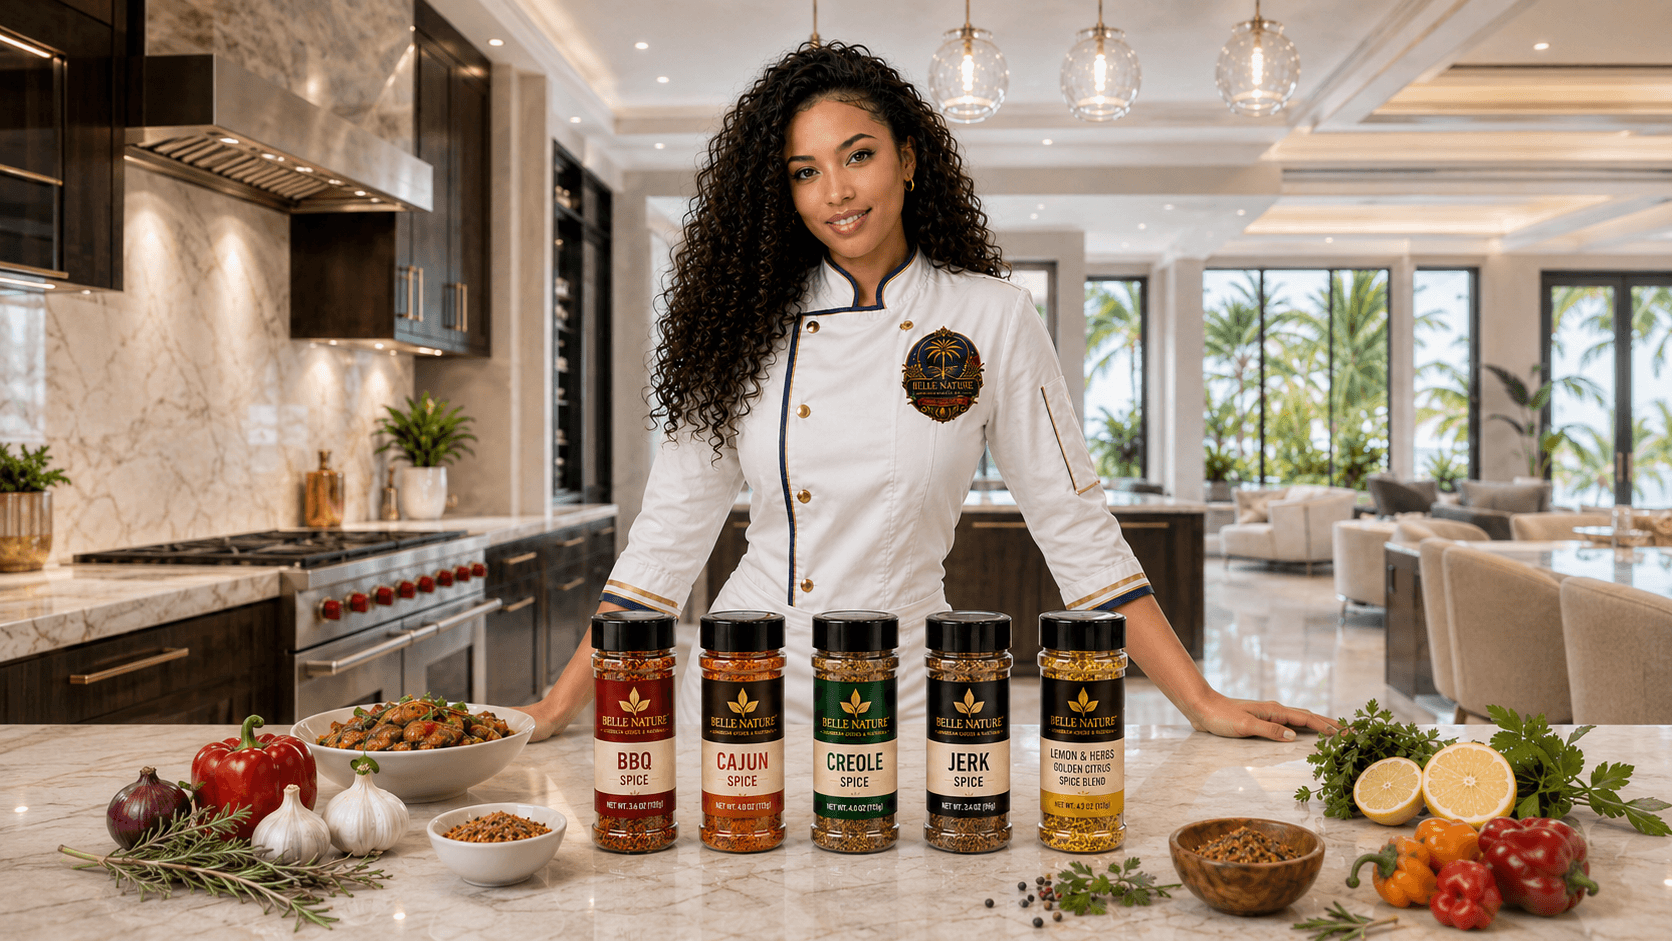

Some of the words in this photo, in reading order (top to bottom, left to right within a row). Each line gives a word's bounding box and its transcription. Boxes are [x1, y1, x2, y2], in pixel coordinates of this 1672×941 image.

[913, 381, 937, 390] BELLE
[940, 381, 973, 390] NATURE
[602, 716, 629, 728] BELLE
[631, 715, 668, 728] NATURE
[711, 716, 737, 728] BELLE
[740, 716, 776, 728] NATURE
[822, 717, 849, 728] BELLE
[852, 717, 888, 729] NATURE
[936, 716, 963, 728] BELLE
[966, 716, 1002, 729] NATURE
[1050, 715, 1077, 728] BELLE
[1080, 716, 1116, 728] NATURE
[1050, 748, 1077, 760] LEMON
[1080, 751, 1087, 761] &
[1090, 749, 1114, 760] HERBS
[618, 752, 652, 770] BBQ
[717, 752, 768, 770] CAJUN
[827, 752, 884, 772] CREOLE
[948, 752, 990, 772] JERK
[1054, 762, 1082, 773] GOLDEN
[1085, 763, 1111, 774] CITRUS
[620, 774, 648, 786] SPICE
[728, 775, 757, 786] SPICE
[840, 776, 869, 788] SPICE
[954, 776, 984, 788] SPICE
[1059, 776, 1080, 786] SPICE
[1083, 777, 1106, 786] BLEND
[607, 801, 617, 809] NET
[639, 802, 646, 810] OZ
[827, 803, 837, 811] NET
[858, 804, 866, 812] OZ
[942, 802, 952, 810] NET
[974, 803, 981, 811] OZ
